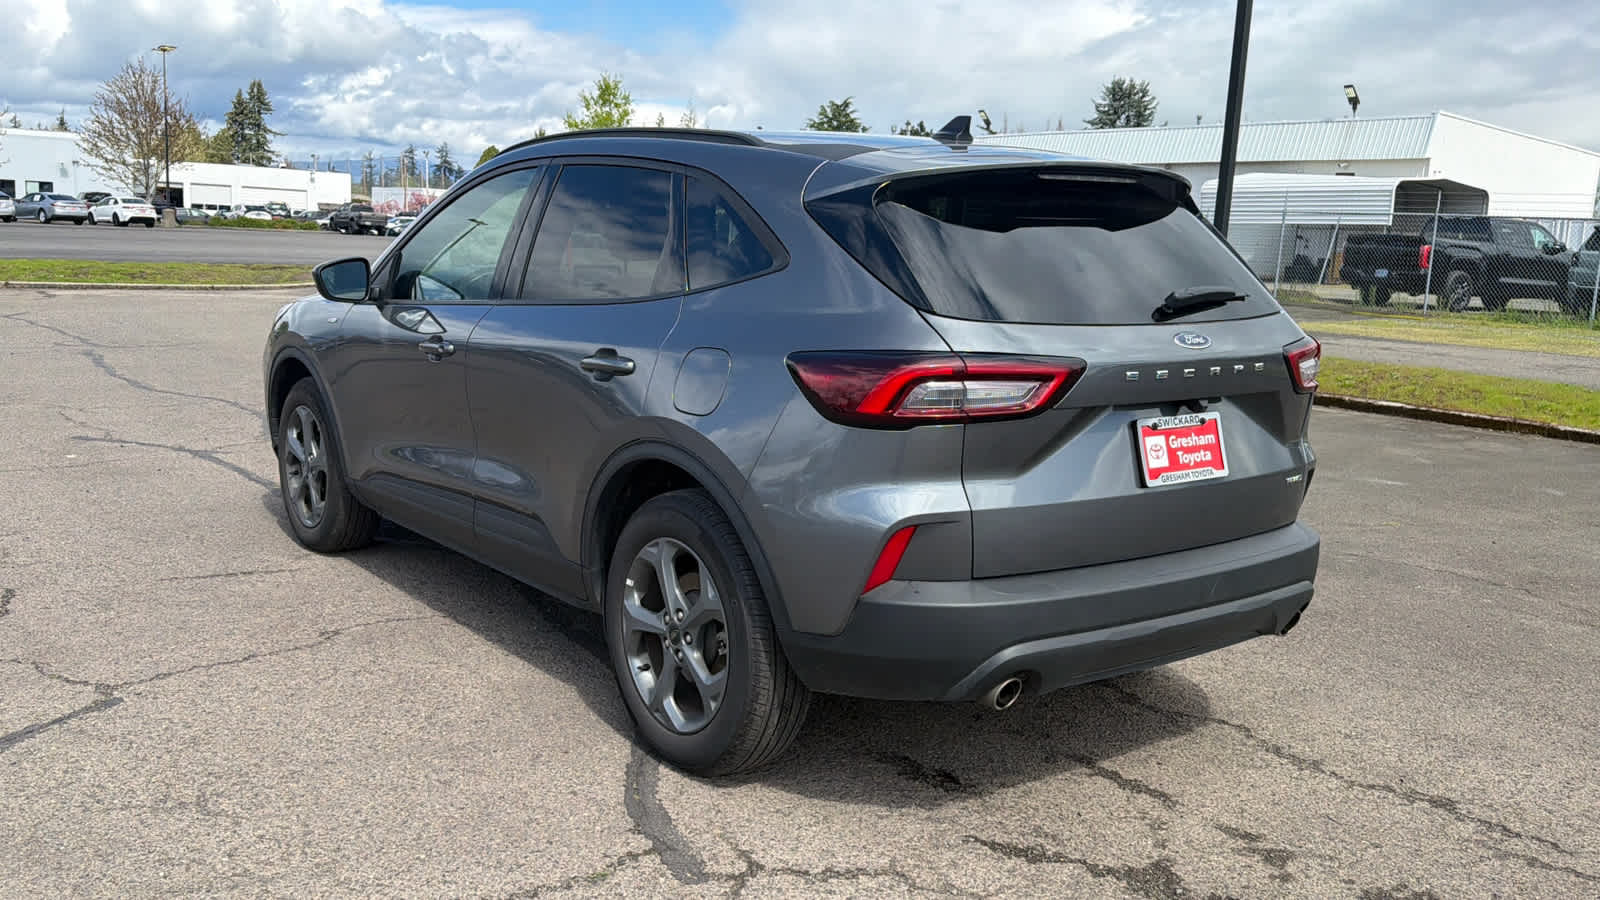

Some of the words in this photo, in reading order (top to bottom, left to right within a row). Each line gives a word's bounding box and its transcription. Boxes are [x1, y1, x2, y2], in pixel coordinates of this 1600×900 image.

[1183, 334, 1206, 345] Ford
[1126, 362, 1264, 380] ESCAPE
[1158, 416, 1200, 427] SWICKARD
[1169, 433, 1215, 448] Gresham
[1176, 450, 1212, 466] Toyota
[1161, 472, 1190, 482] GRESHAM
[1191, 469, 1214, 479] TOYOTA
